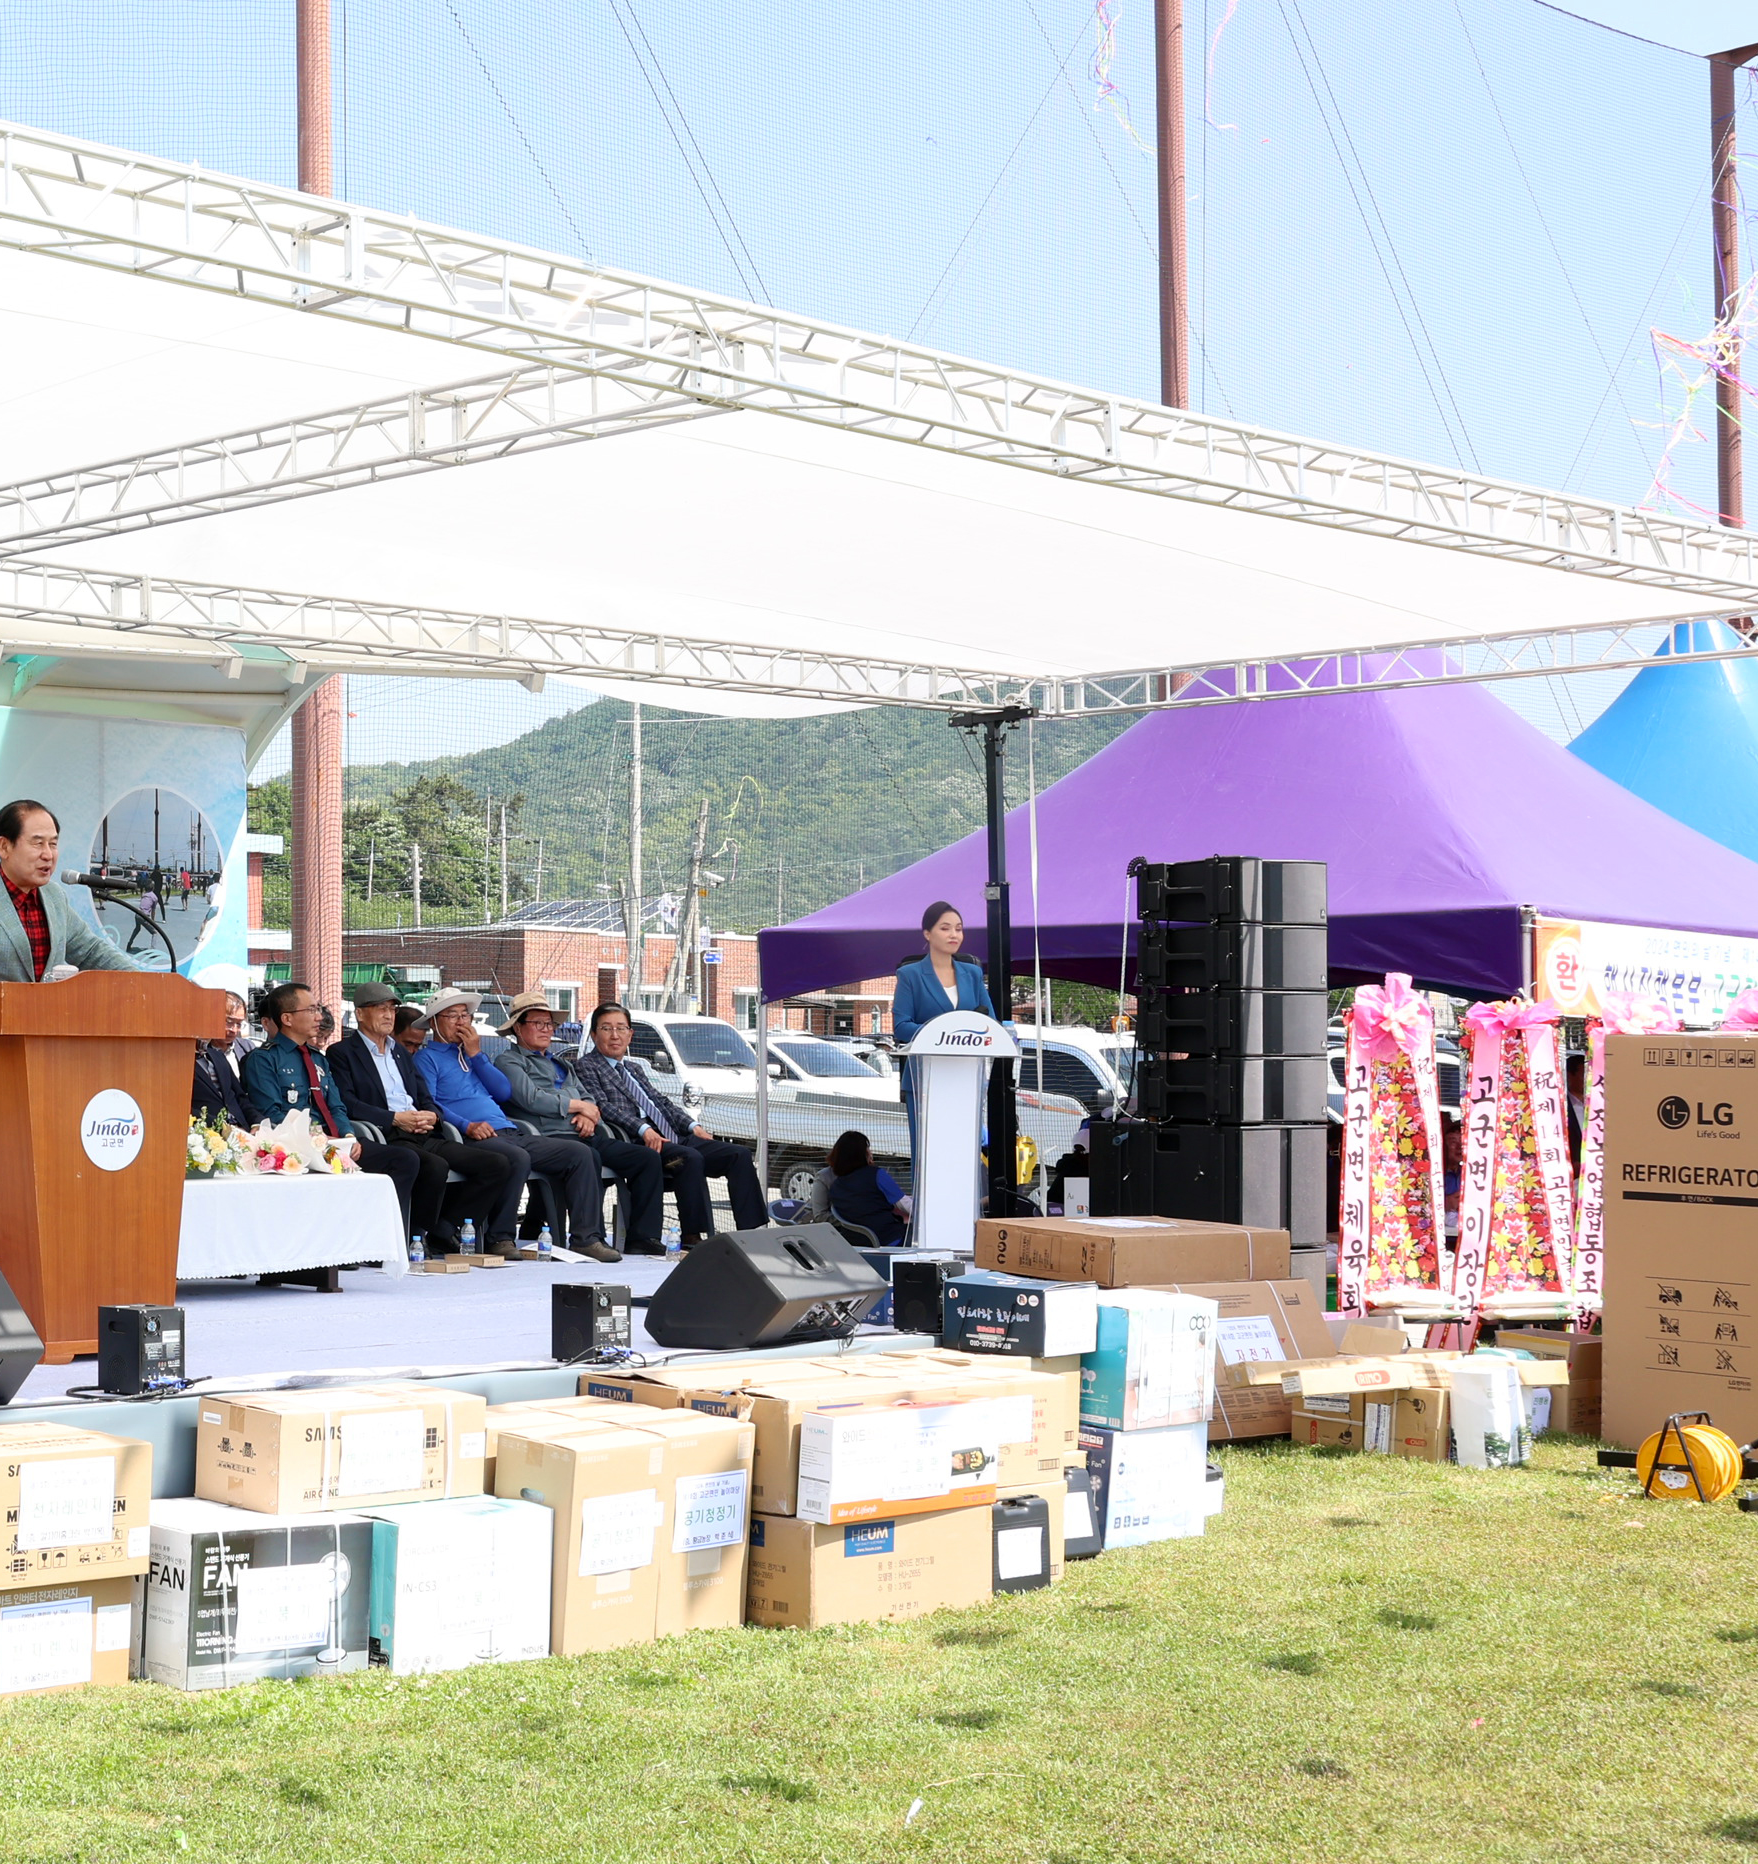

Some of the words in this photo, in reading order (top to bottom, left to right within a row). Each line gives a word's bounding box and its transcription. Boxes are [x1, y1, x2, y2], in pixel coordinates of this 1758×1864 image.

[1556, 952, 1578, 991] 환
[935, 1031, 982, 1047] Jindo
[1534, 1071, 1558, 1091] 祝
[1348, 1065, 1369, 1181] 고군면
[1697, 1102, 1733, 1125] LG
[87, 1119, 130, 1138] Jindo
[1468, 1076, 1496, 1191] 고군면
[1719, 1131, 1740, 1139] Good
[102, 1138, 124, 1148] 고군면
[1622, 1164, 1758, 1188] REFRIGERATO
[1343, 1199, 1367, 1318] 체육회
[303, 1490, 316, 1500] AIR
[684, 1504, 736, 1527] 공기청정기
[851, 1526, 888, 1543] HEUM
[149, 1561, 186, 1591] FAN
[14, 1591, 37, 1605] 인버터
[39, 1587, 79, 1602] 전자레인지
